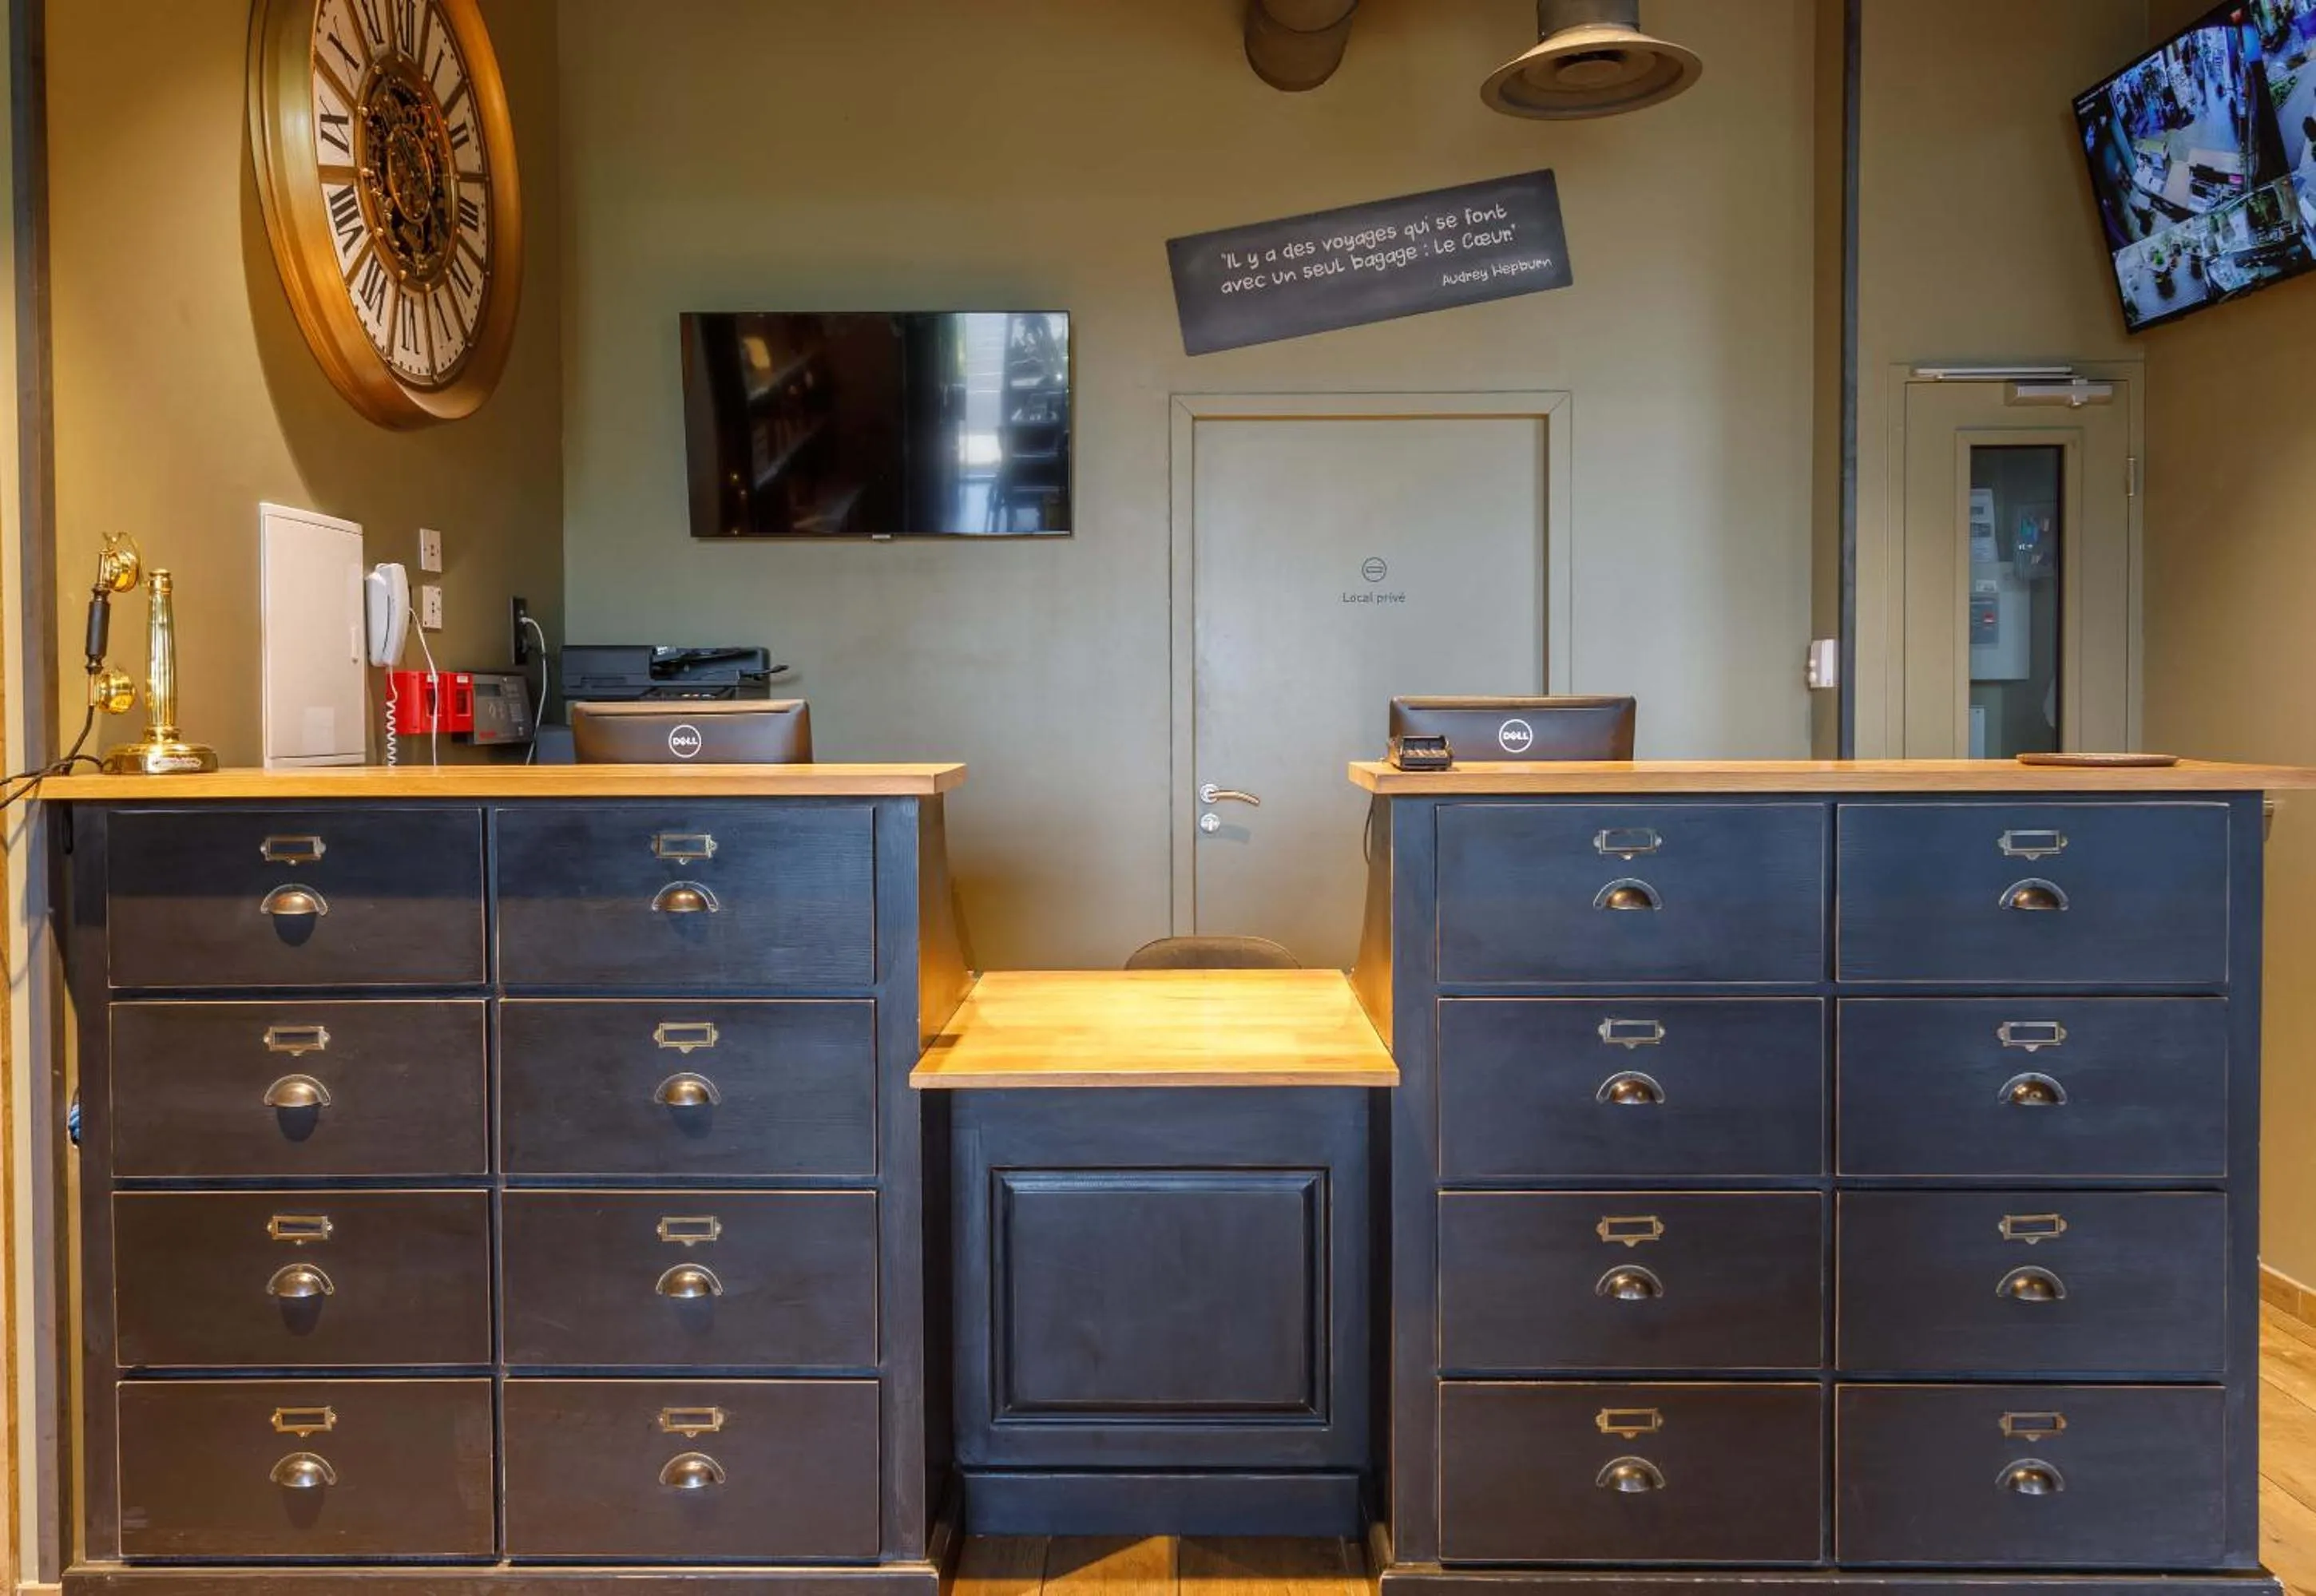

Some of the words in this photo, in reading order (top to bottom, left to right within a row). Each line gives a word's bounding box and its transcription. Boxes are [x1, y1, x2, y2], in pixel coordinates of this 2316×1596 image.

[1247, 253, 1259, 270] y
[1265, 249, 1276, 263] a
[1283, 242, 1316, 259] des
[1323, 226, 1397, 252] voyages
[1405, 216, 1430, 241] qui
[1437, 215, 1457, 231] se
[1465, 204, 1508, 226] font
[1221, 274, 1266, 294] avec
[1271, 270, 1297, 284] un
[1303, 258, 1345, 278] seul
[1350, 246, 1418, 271] bagage
[1442, 268, 1489, 287] Audrey
[1491, 257, 1553, 277] Hepburn
[1342, 592, 1374, 603] Local
[1376, 591, 1406, 605] privé
[672, 736, 698, 746] DELL
[1503, 730, 1529, 740] DELL
